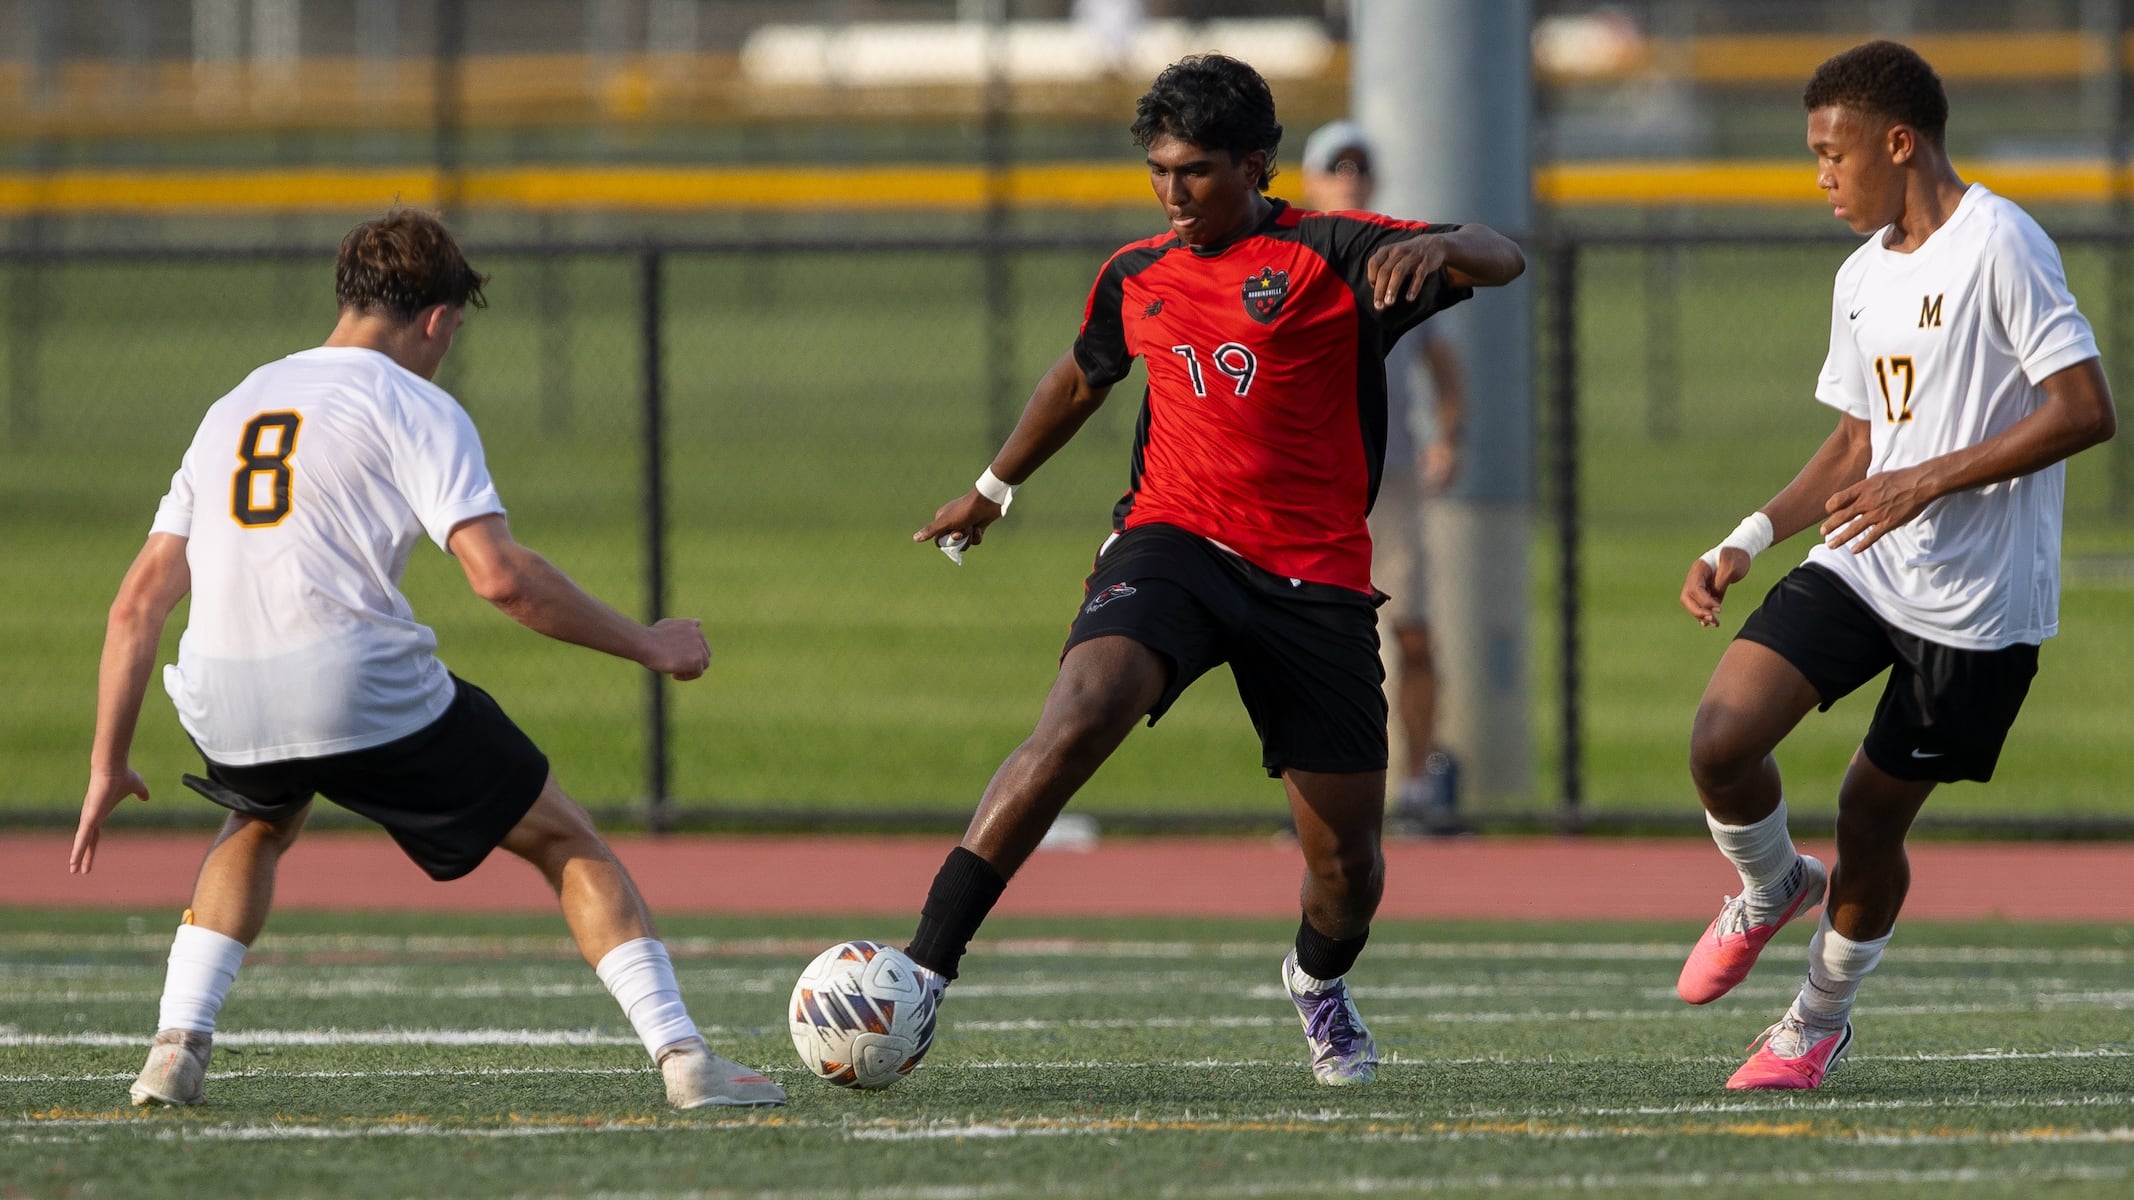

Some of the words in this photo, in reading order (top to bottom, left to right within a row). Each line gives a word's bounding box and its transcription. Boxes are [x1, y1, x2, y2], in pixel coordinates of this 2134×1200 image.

[1918, 293, 1944, 330] M
[1171, 342, 1257, 397] 19
[1874, 355, 1915, 423] 17
[229, 408, 304, 529] 8
